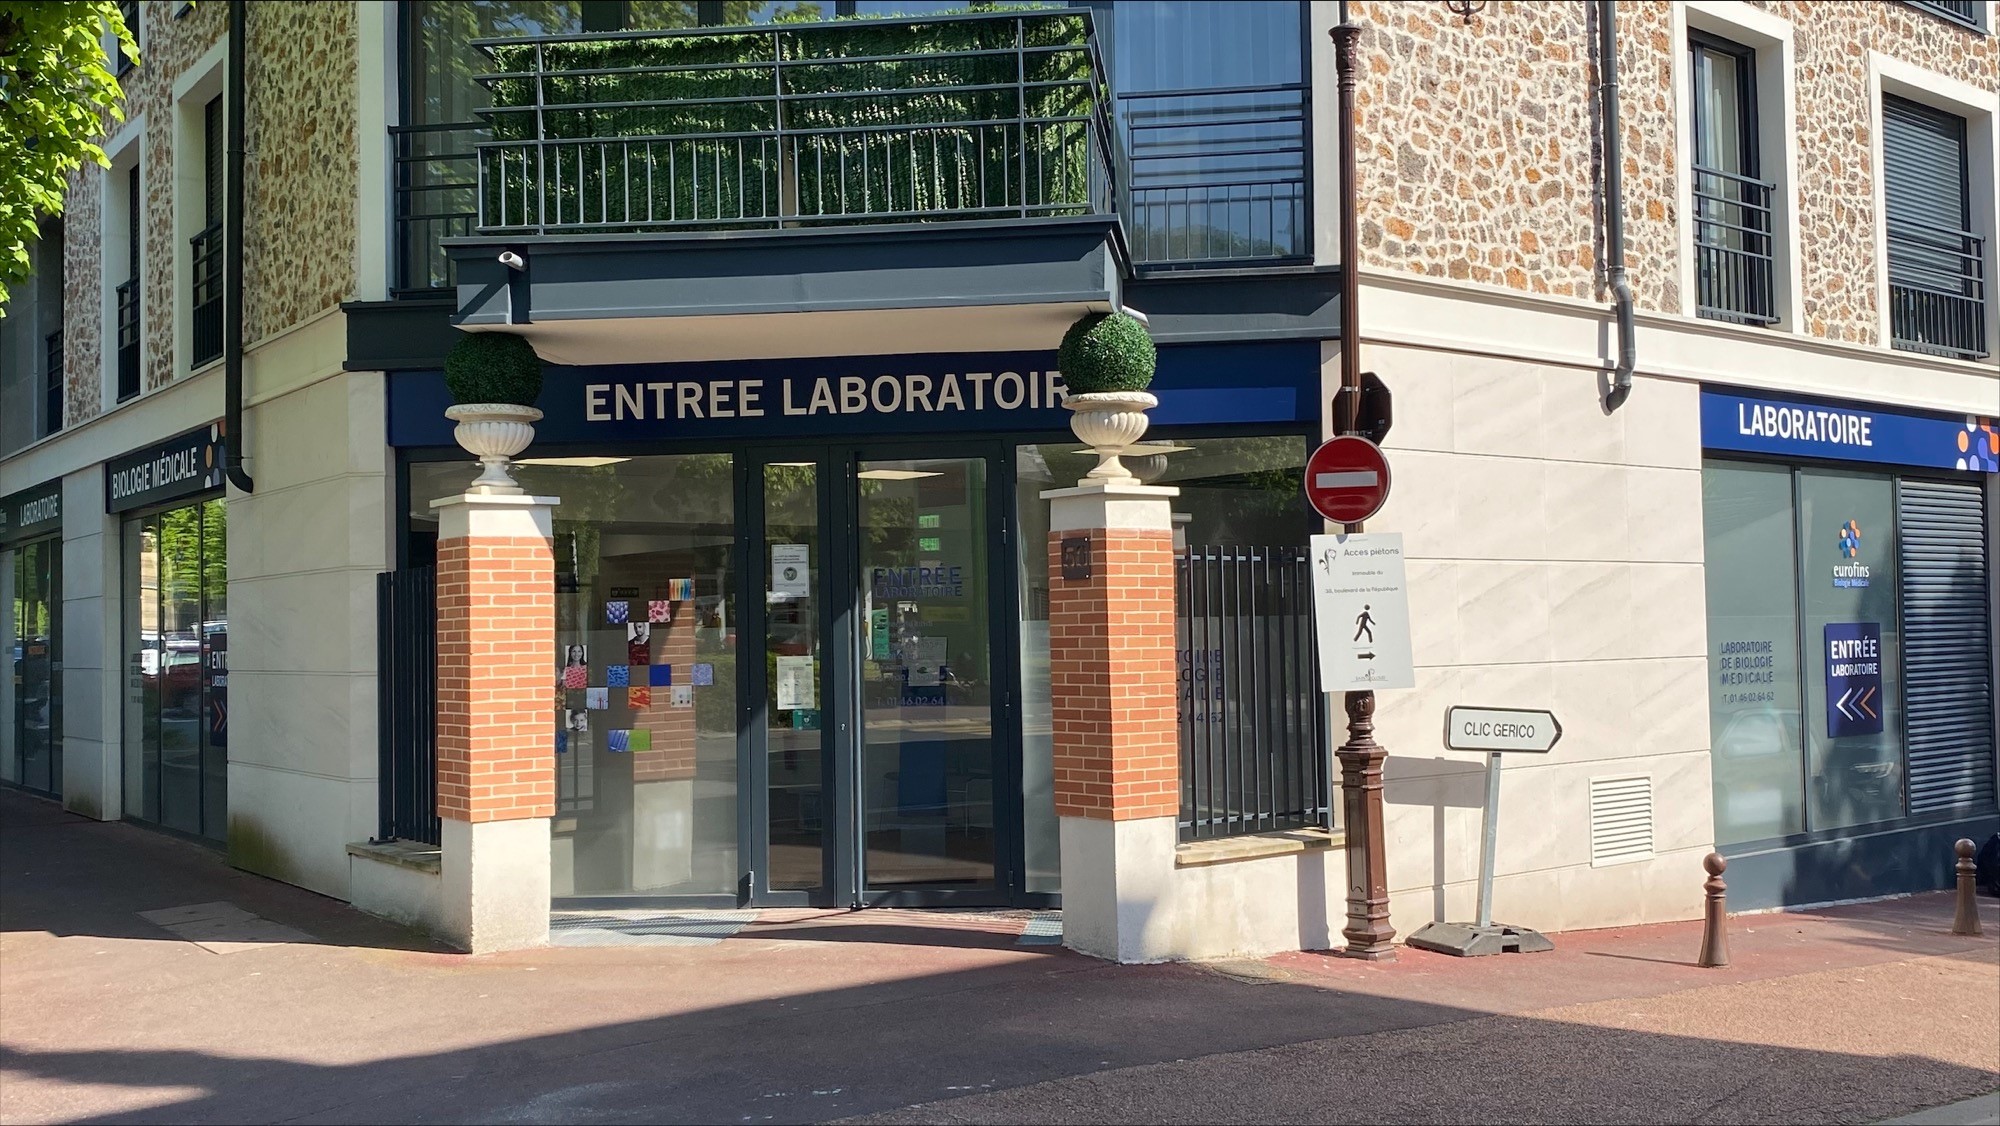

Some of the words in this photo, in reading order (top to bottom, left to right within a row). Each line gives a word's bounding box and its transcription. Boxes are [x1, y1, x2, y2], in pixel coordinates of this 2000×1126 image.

[585, 378, 765, 421] ENTREE
[782, 370, 1068, 416] LABORATOIR
[1739, 403, 1873, 447] LABORATOIRE
[113, 462, 151, 499] BIOLOGIE
[152, 446, 198, 489] MÉDICALE
[20, 493, 59, 527] LABORATOIRE
[874, 563, 962, 586] ENTRÉE
[1833, 562, 1870, 578] eurofins
[875, 585, 962, 598] LABORATOIRE
[1721, 641, 1773, 654] LABORATOIRE
[1831, 636, 1878, 660] ENTRÉE
[1721, 657, 1732, 669] DE
[1735, 655, 1774, 668] BIOLOGIE
[1831, 663, 1878, 677] LABORATOIRE
[1464, 721, 1491, 736] CLIC
[1493, 723, 1535, 739] GERICO
